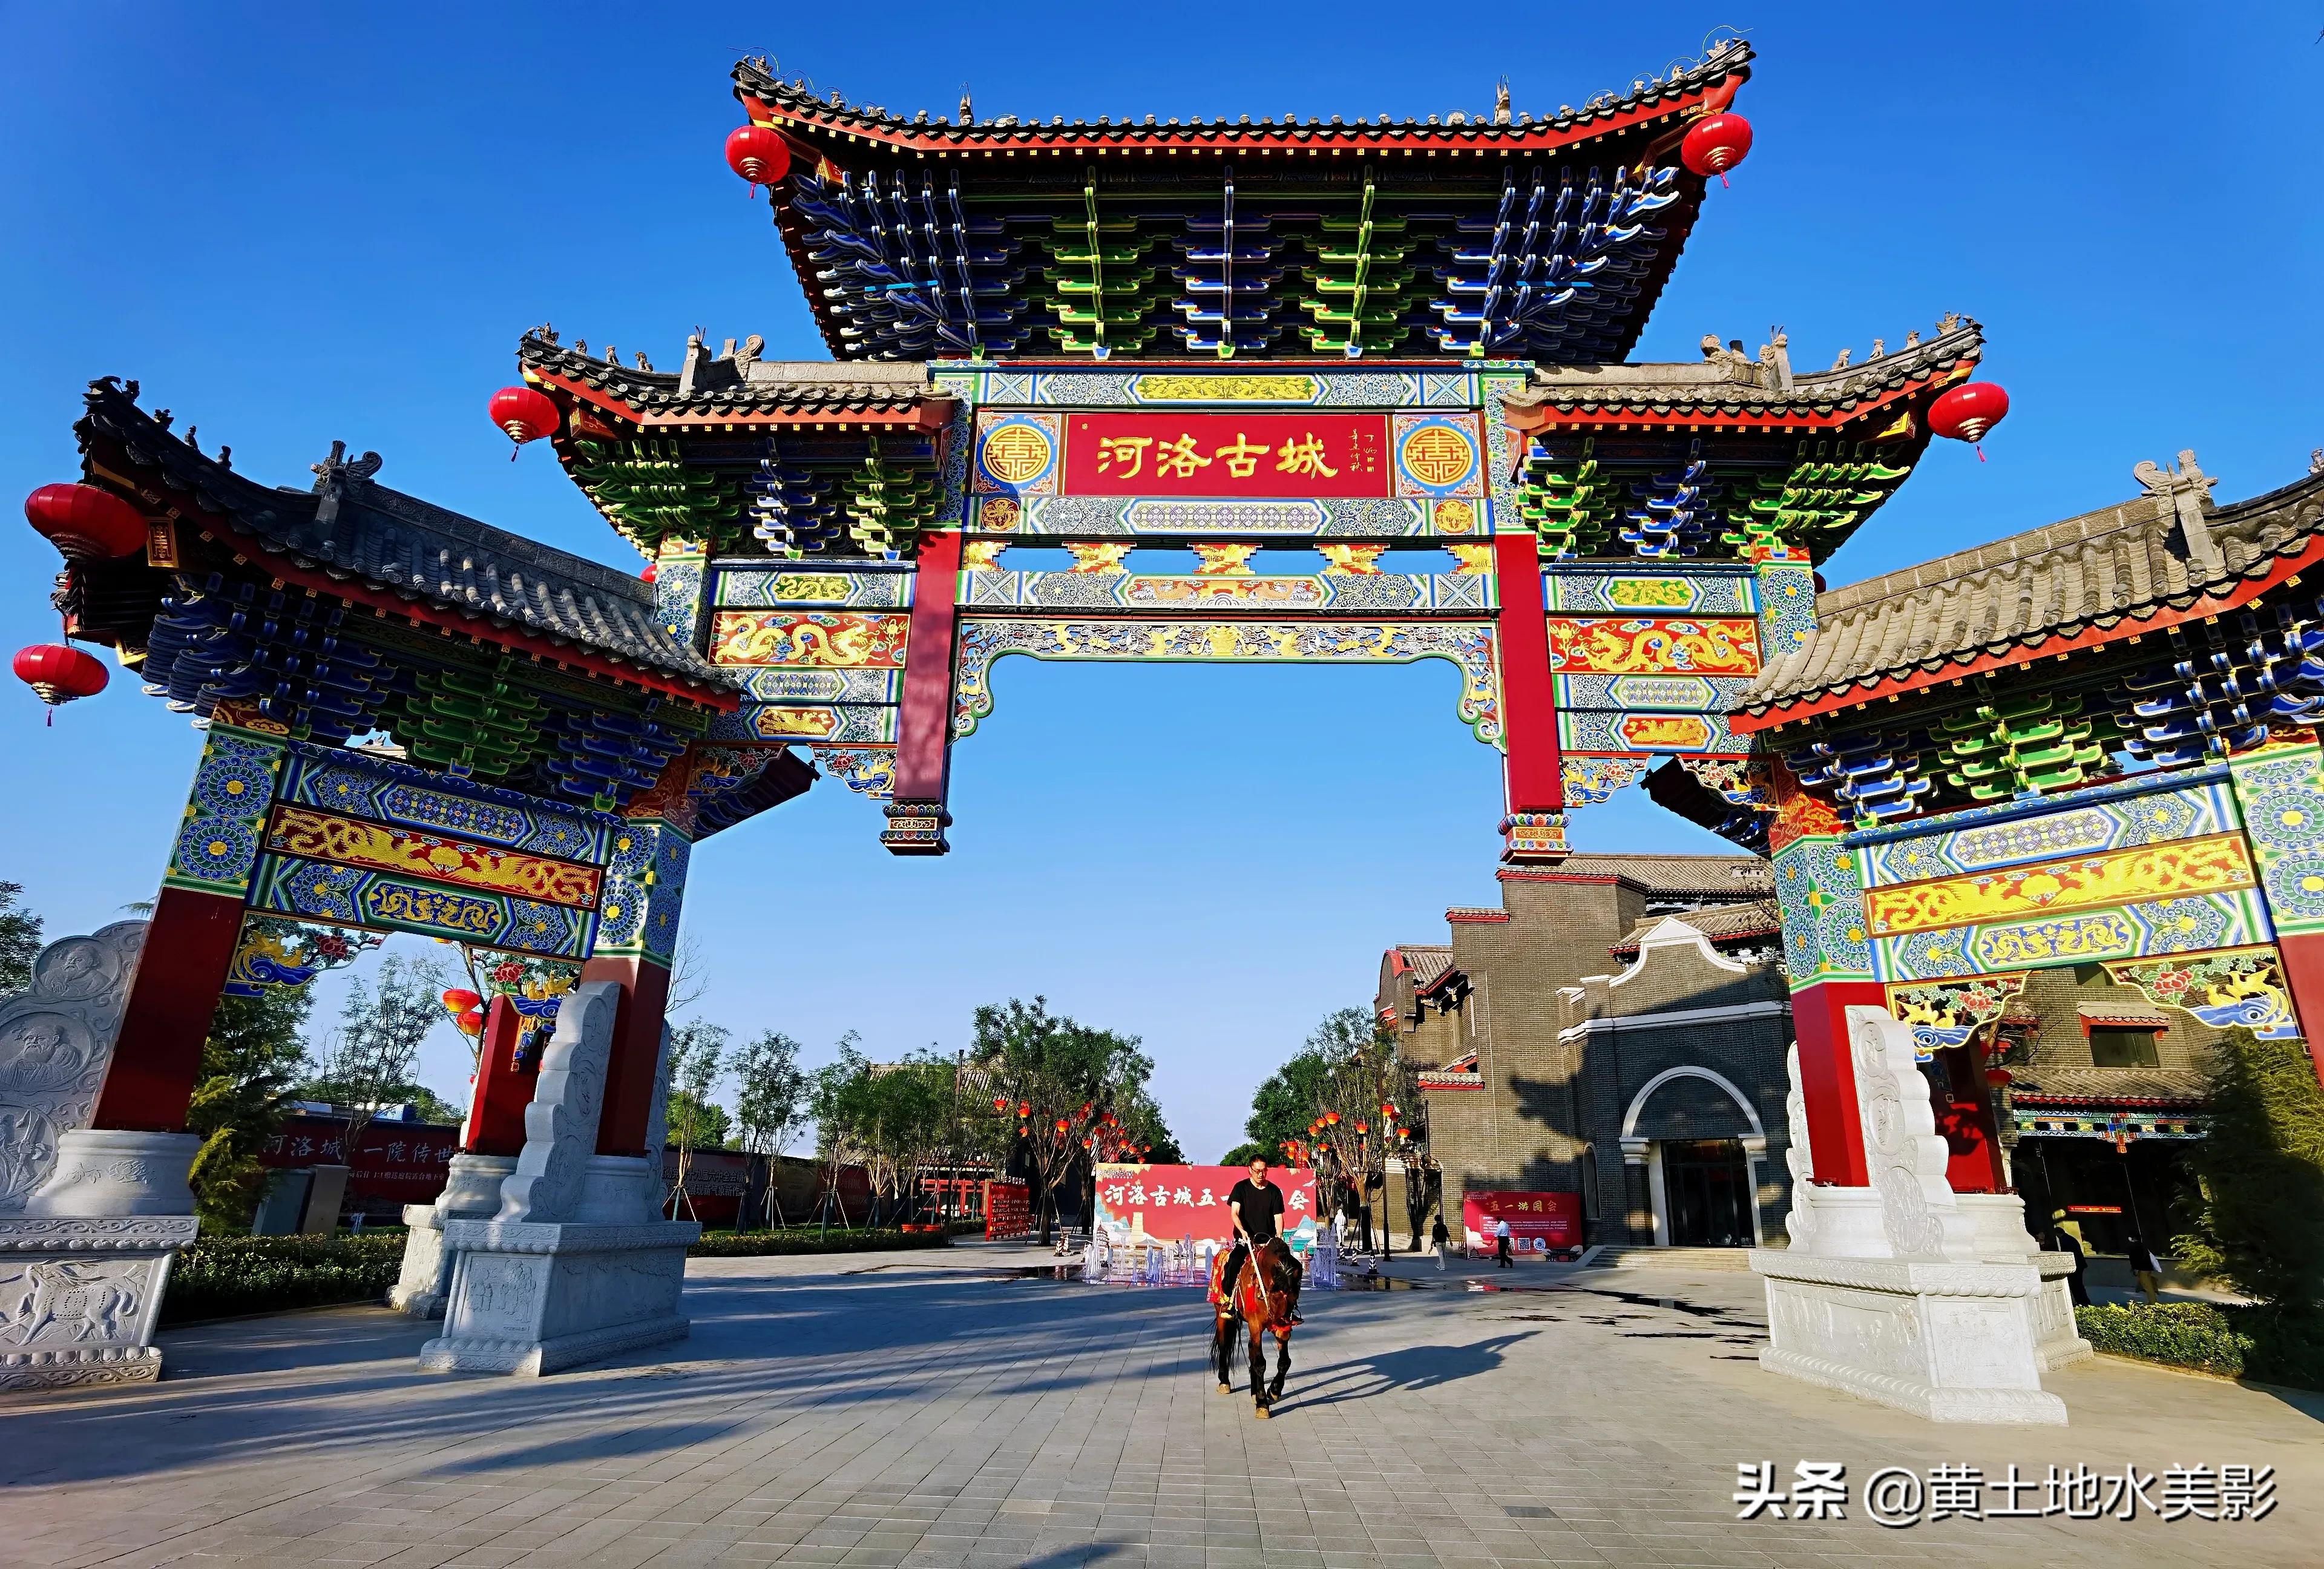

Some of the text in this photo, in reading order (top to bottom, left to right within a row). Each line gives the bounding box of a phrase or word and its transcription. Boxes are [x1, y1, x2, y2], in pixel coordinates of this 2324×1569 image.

[1097, 432, 1338, 479] 河洛古城
[1105, 1184, 1310, 1211] 河洛古城五一会
[1490, 1200, 1557, 1212] 五一游园会
